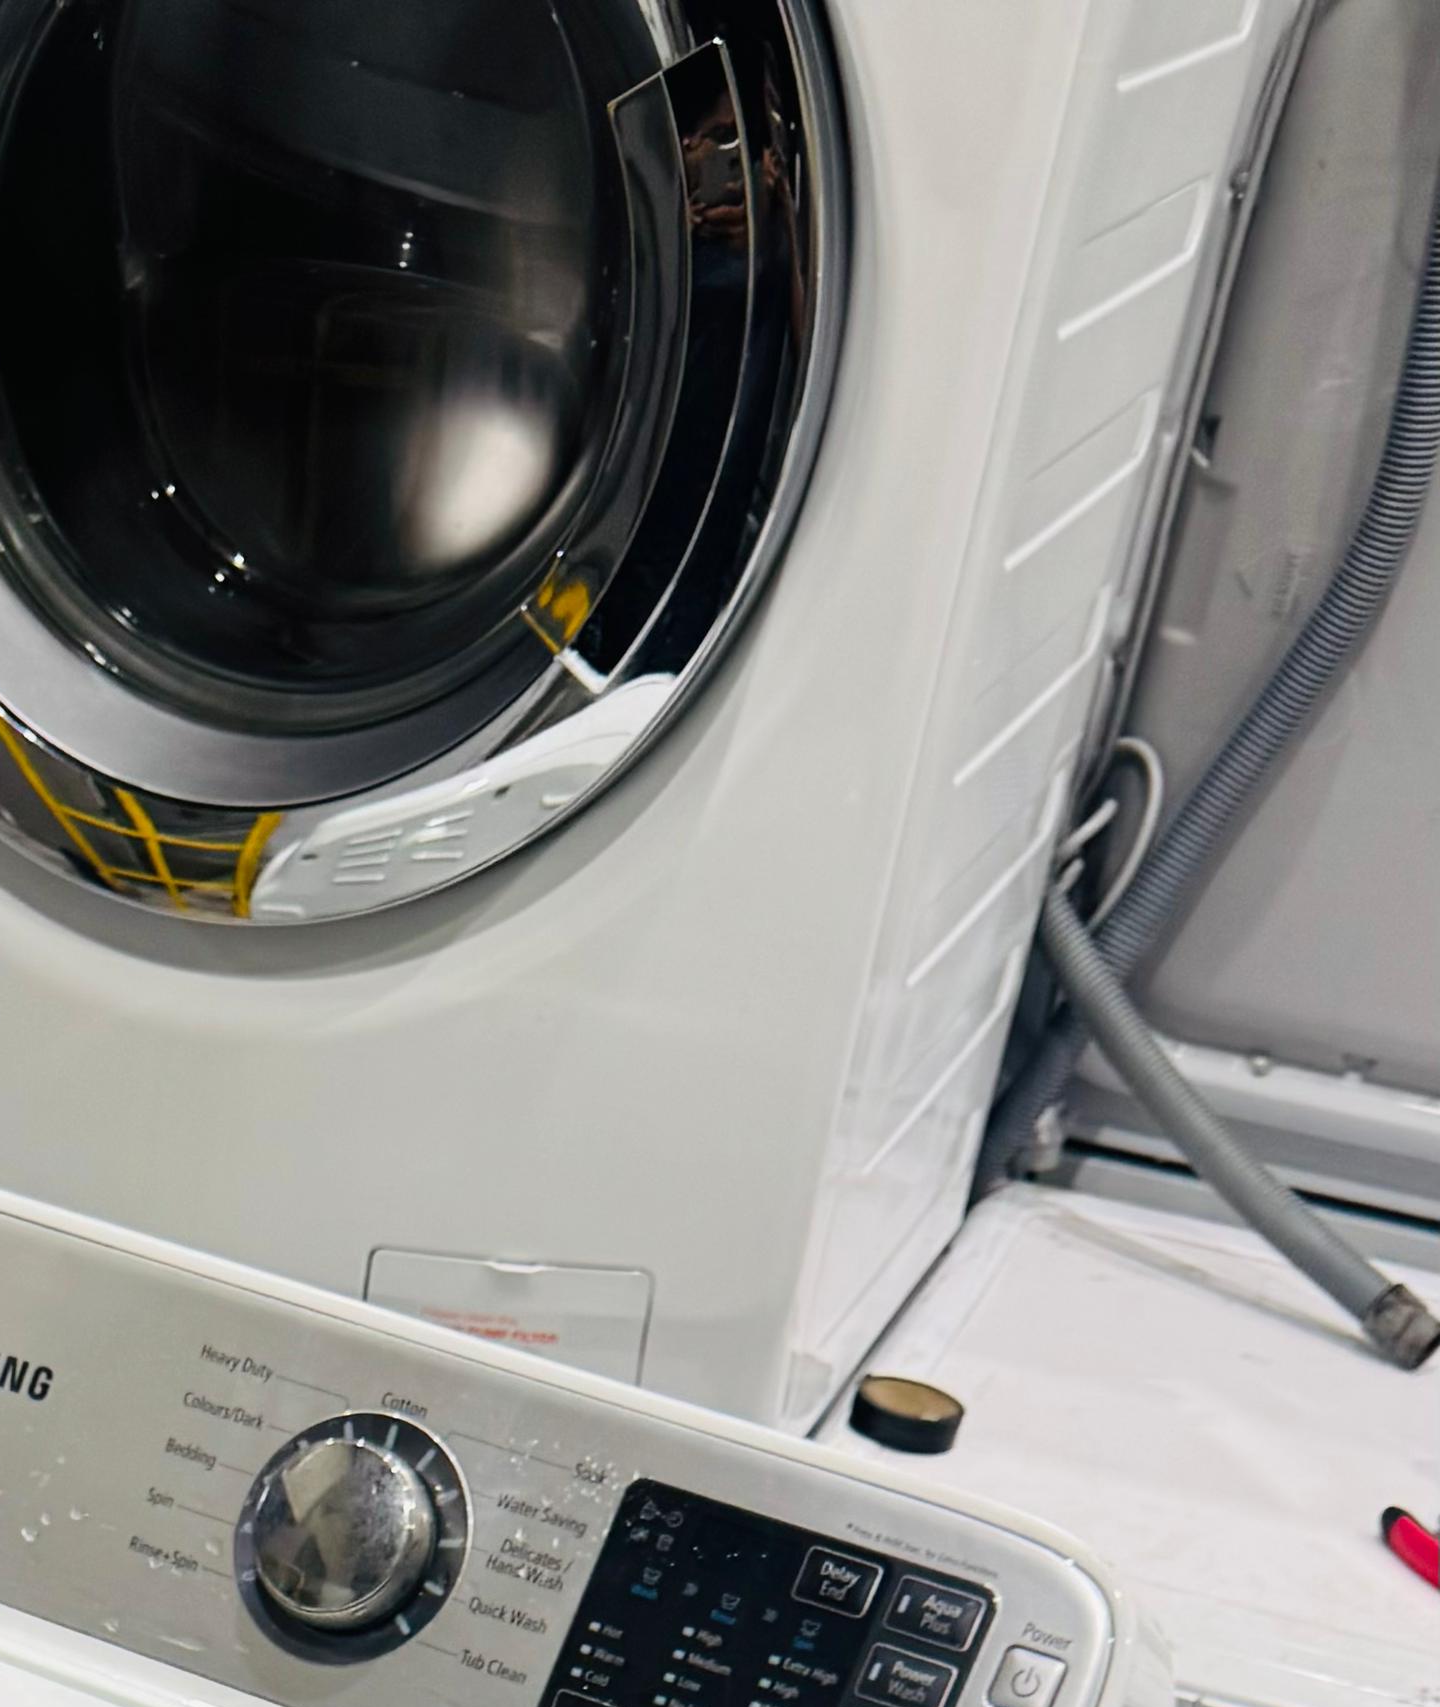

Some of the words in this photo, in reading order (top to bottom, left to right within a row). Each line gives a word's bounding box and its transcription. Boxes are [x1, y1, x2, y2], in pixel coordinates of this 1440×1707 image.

[200, 1344, 240, 1372] Heavy
[242, 1357, 274, 1382] Duty
[183, 1391, 263, 1430] Colours/Dark
[381, 1391, 428, 1420] Cotton
[165, 1436, 216, 1471] Bedding
[146, 1486, 174, 1509] Spin
[497, 1493, 540, 1520] Water
[542, 1504, 589, 1539] Saving
[500, 1538, 562, 1572] Delicates
[486, 1554, 524, 1578] Hand
[525, 1567, 564, 1594] Wash
[819, 1560, 862, 1590] Delay
[818, 1580, 848, 1602] End
[468, 1596, 509, 1624] Quick
[510, 1608, 548, 1635] Wash
[921, 1594, 963, 1620] Aqua
[919, 1612, 952, 1636] Plus
[1020, 1621, 1073, 1650] Power
[461, 1648, 486, 1673] Tub
[487, 1658, 528, 1684] Clean
[584, 1669, 611, 1688] Cold
[890, 1660, 938, 1686] Power
[886, 1678, 927, 1703] Wash
